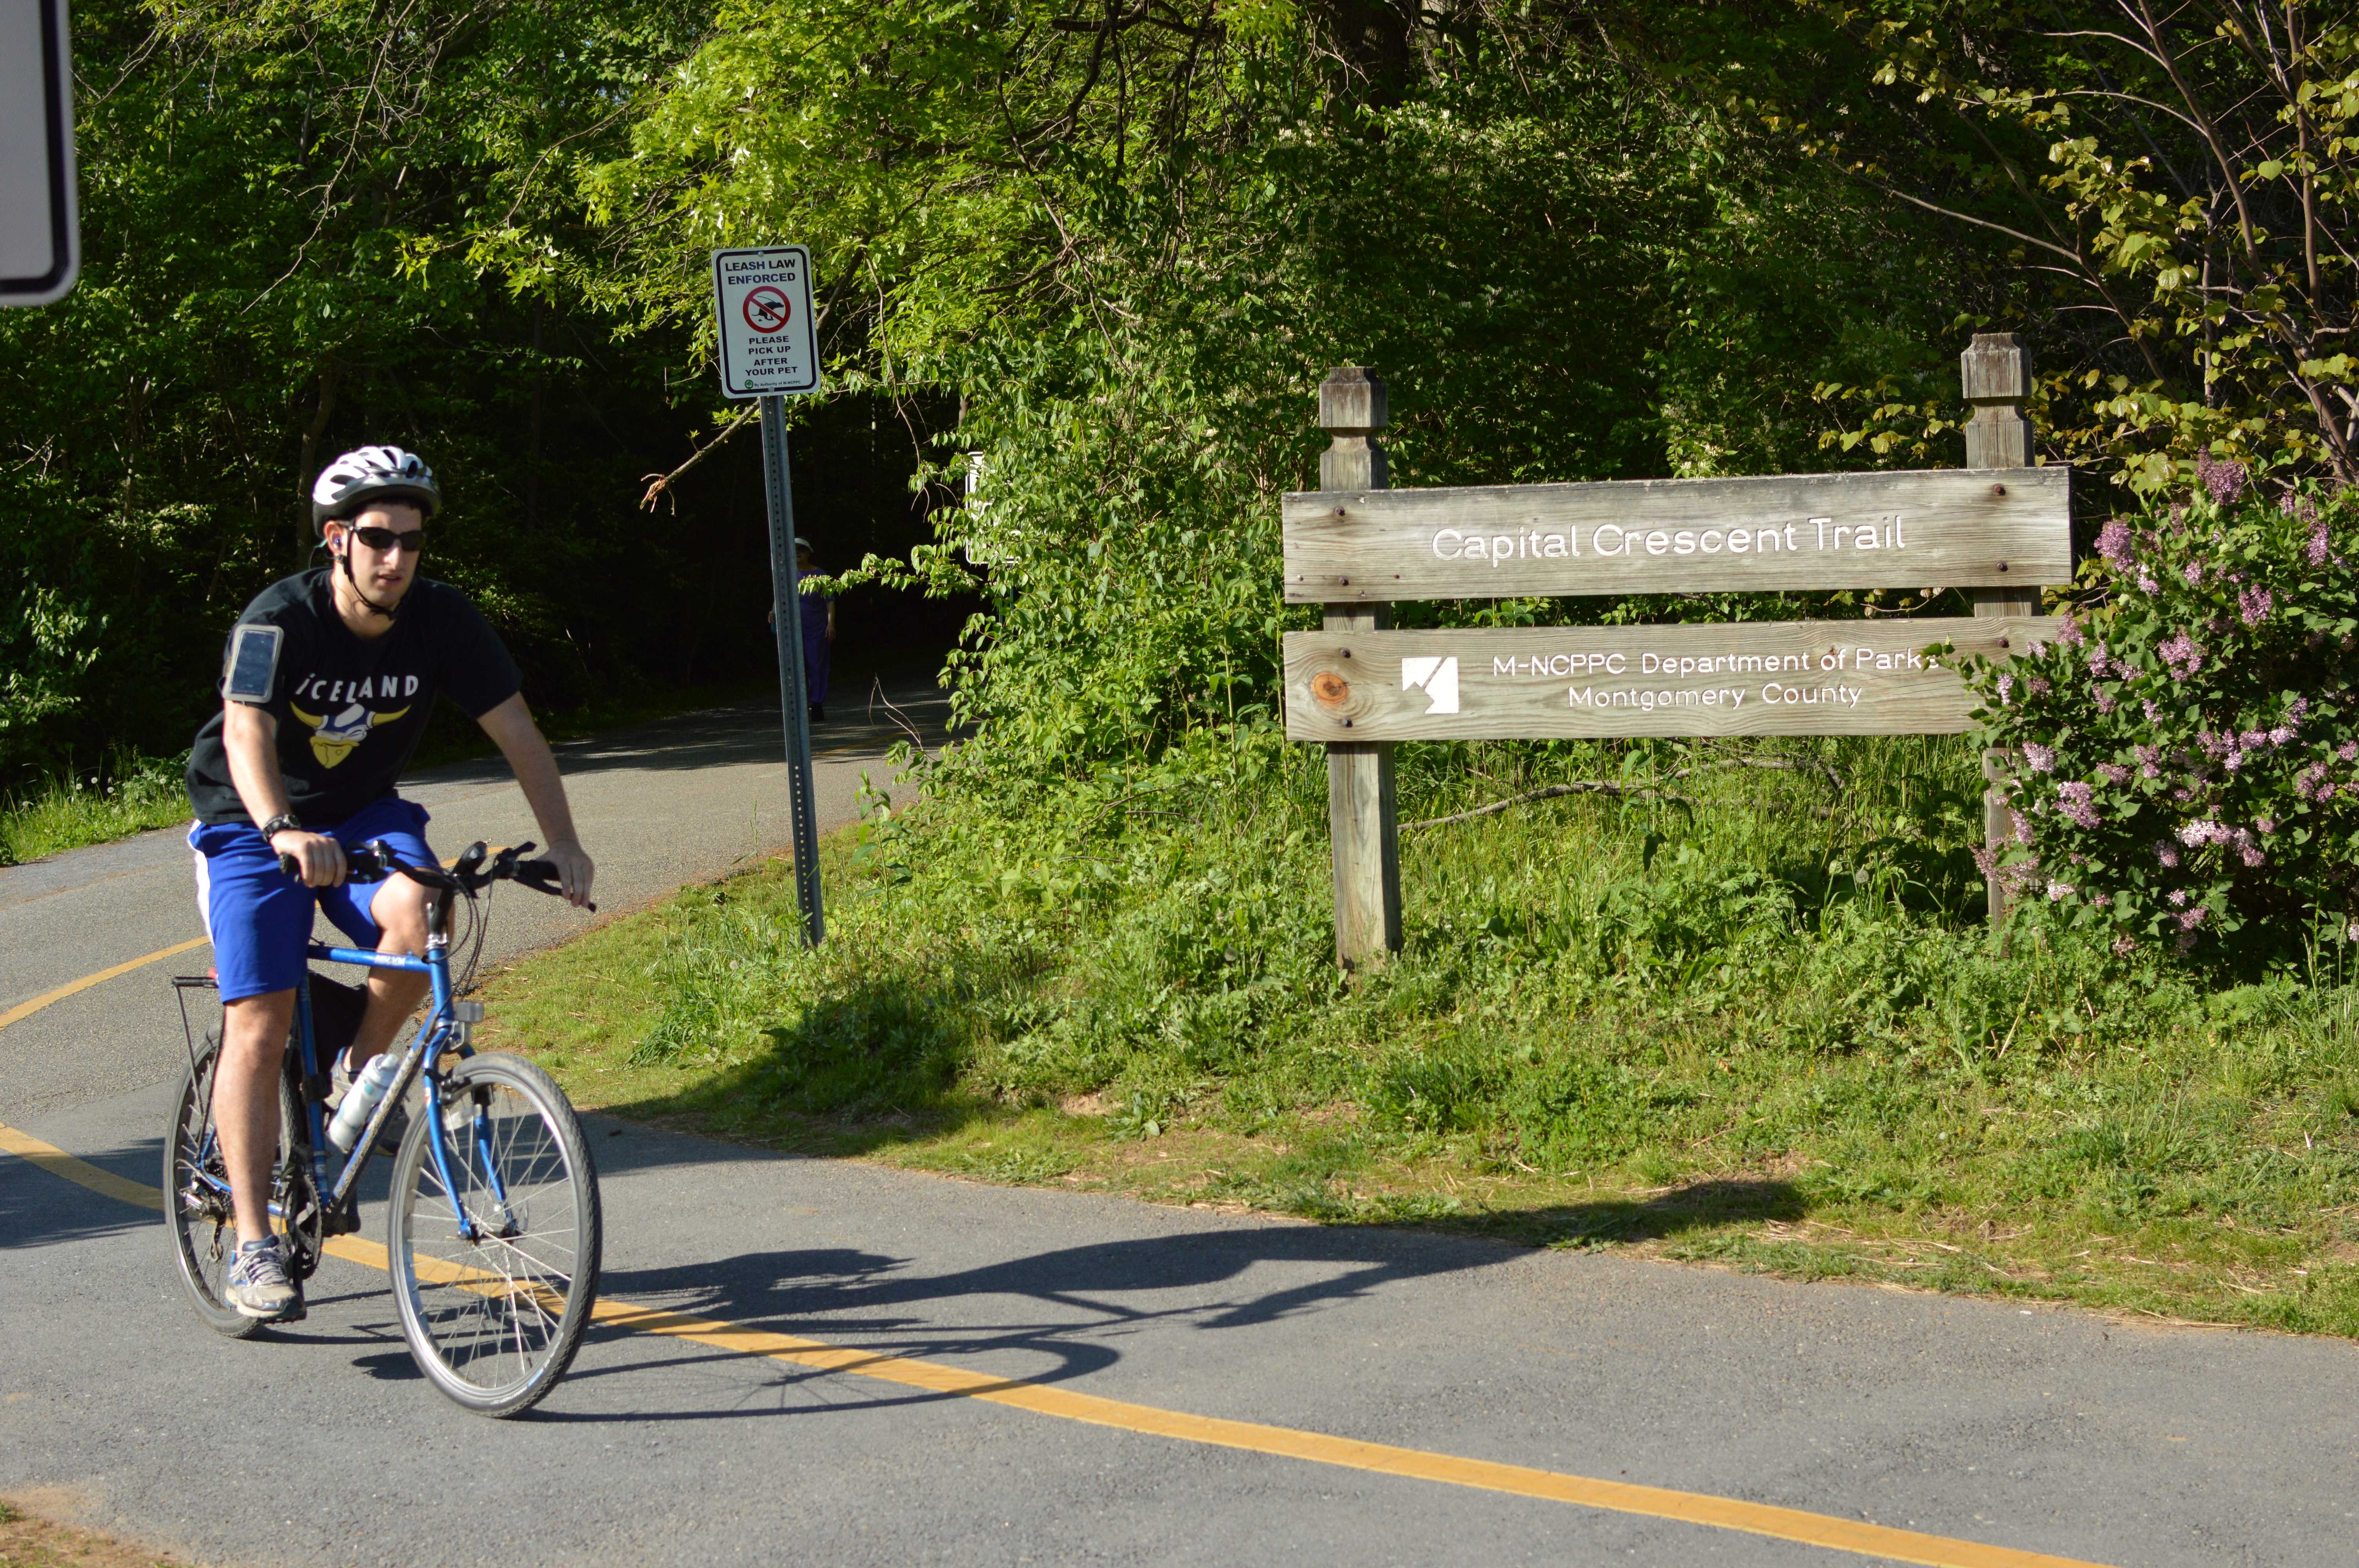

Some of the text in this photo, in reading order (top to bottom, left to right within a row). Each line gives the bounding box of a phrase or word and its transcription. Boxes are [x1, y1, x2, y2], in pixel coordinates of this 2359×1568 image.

[725, 259, 796, 272] LEASH LAW
[728, 272, 796, 285] ENFORCED
[749, 336, 789, 345] PLEASE
[754, 358, 788, 366] AFTER
[1431, 516, 1906, 568] Capital Crescent Trail
[1493, 653, 1627, 677] M-NCPPC
[1641, 653, 1810, 679] Department
[1820, 648, 1848, 671] of
[1568, 682, 1863, 712] Montgomery County
